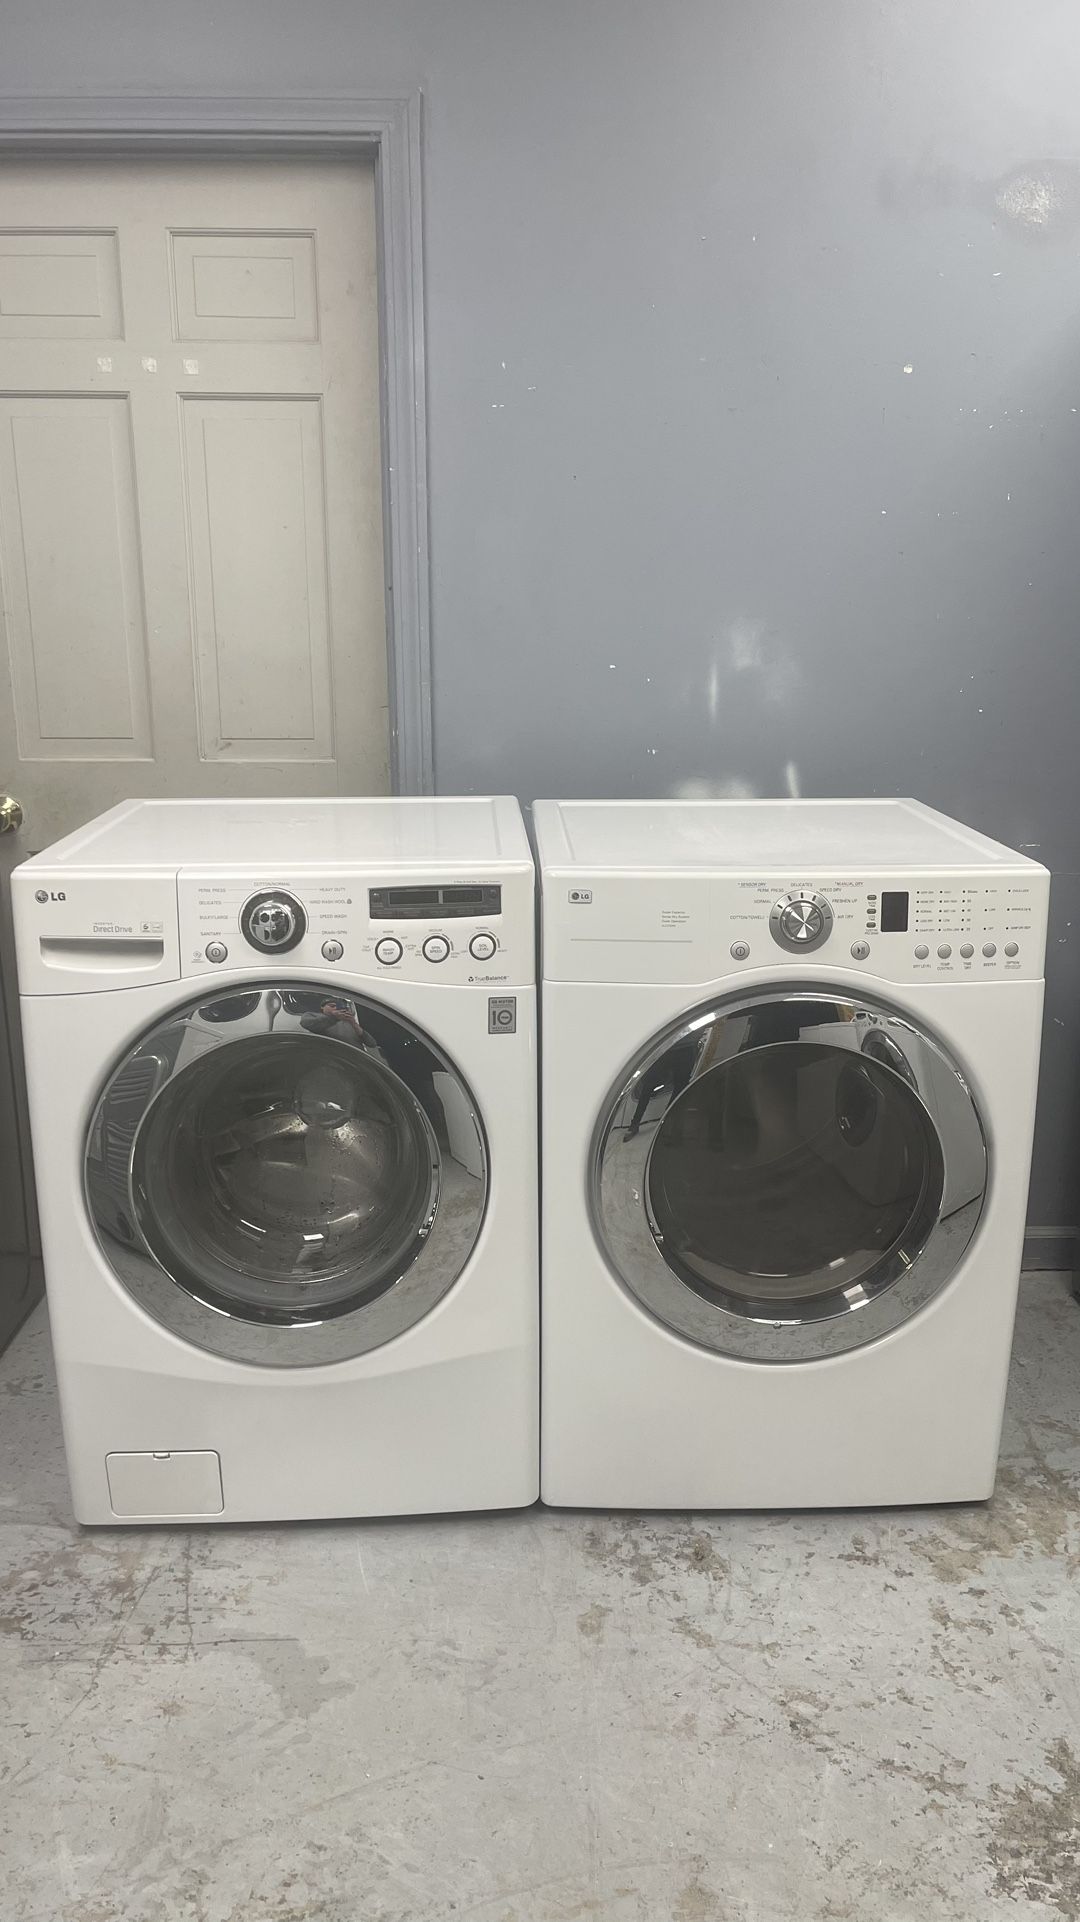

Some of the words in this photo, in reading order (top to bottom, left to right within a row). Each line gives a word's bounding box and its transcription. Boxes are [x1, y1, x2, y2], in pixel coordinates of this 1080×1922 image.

[51, 892, 66, 901] LG
[93, 925, 114, 933] Direct
[115, 925, 133, 933] Drive
